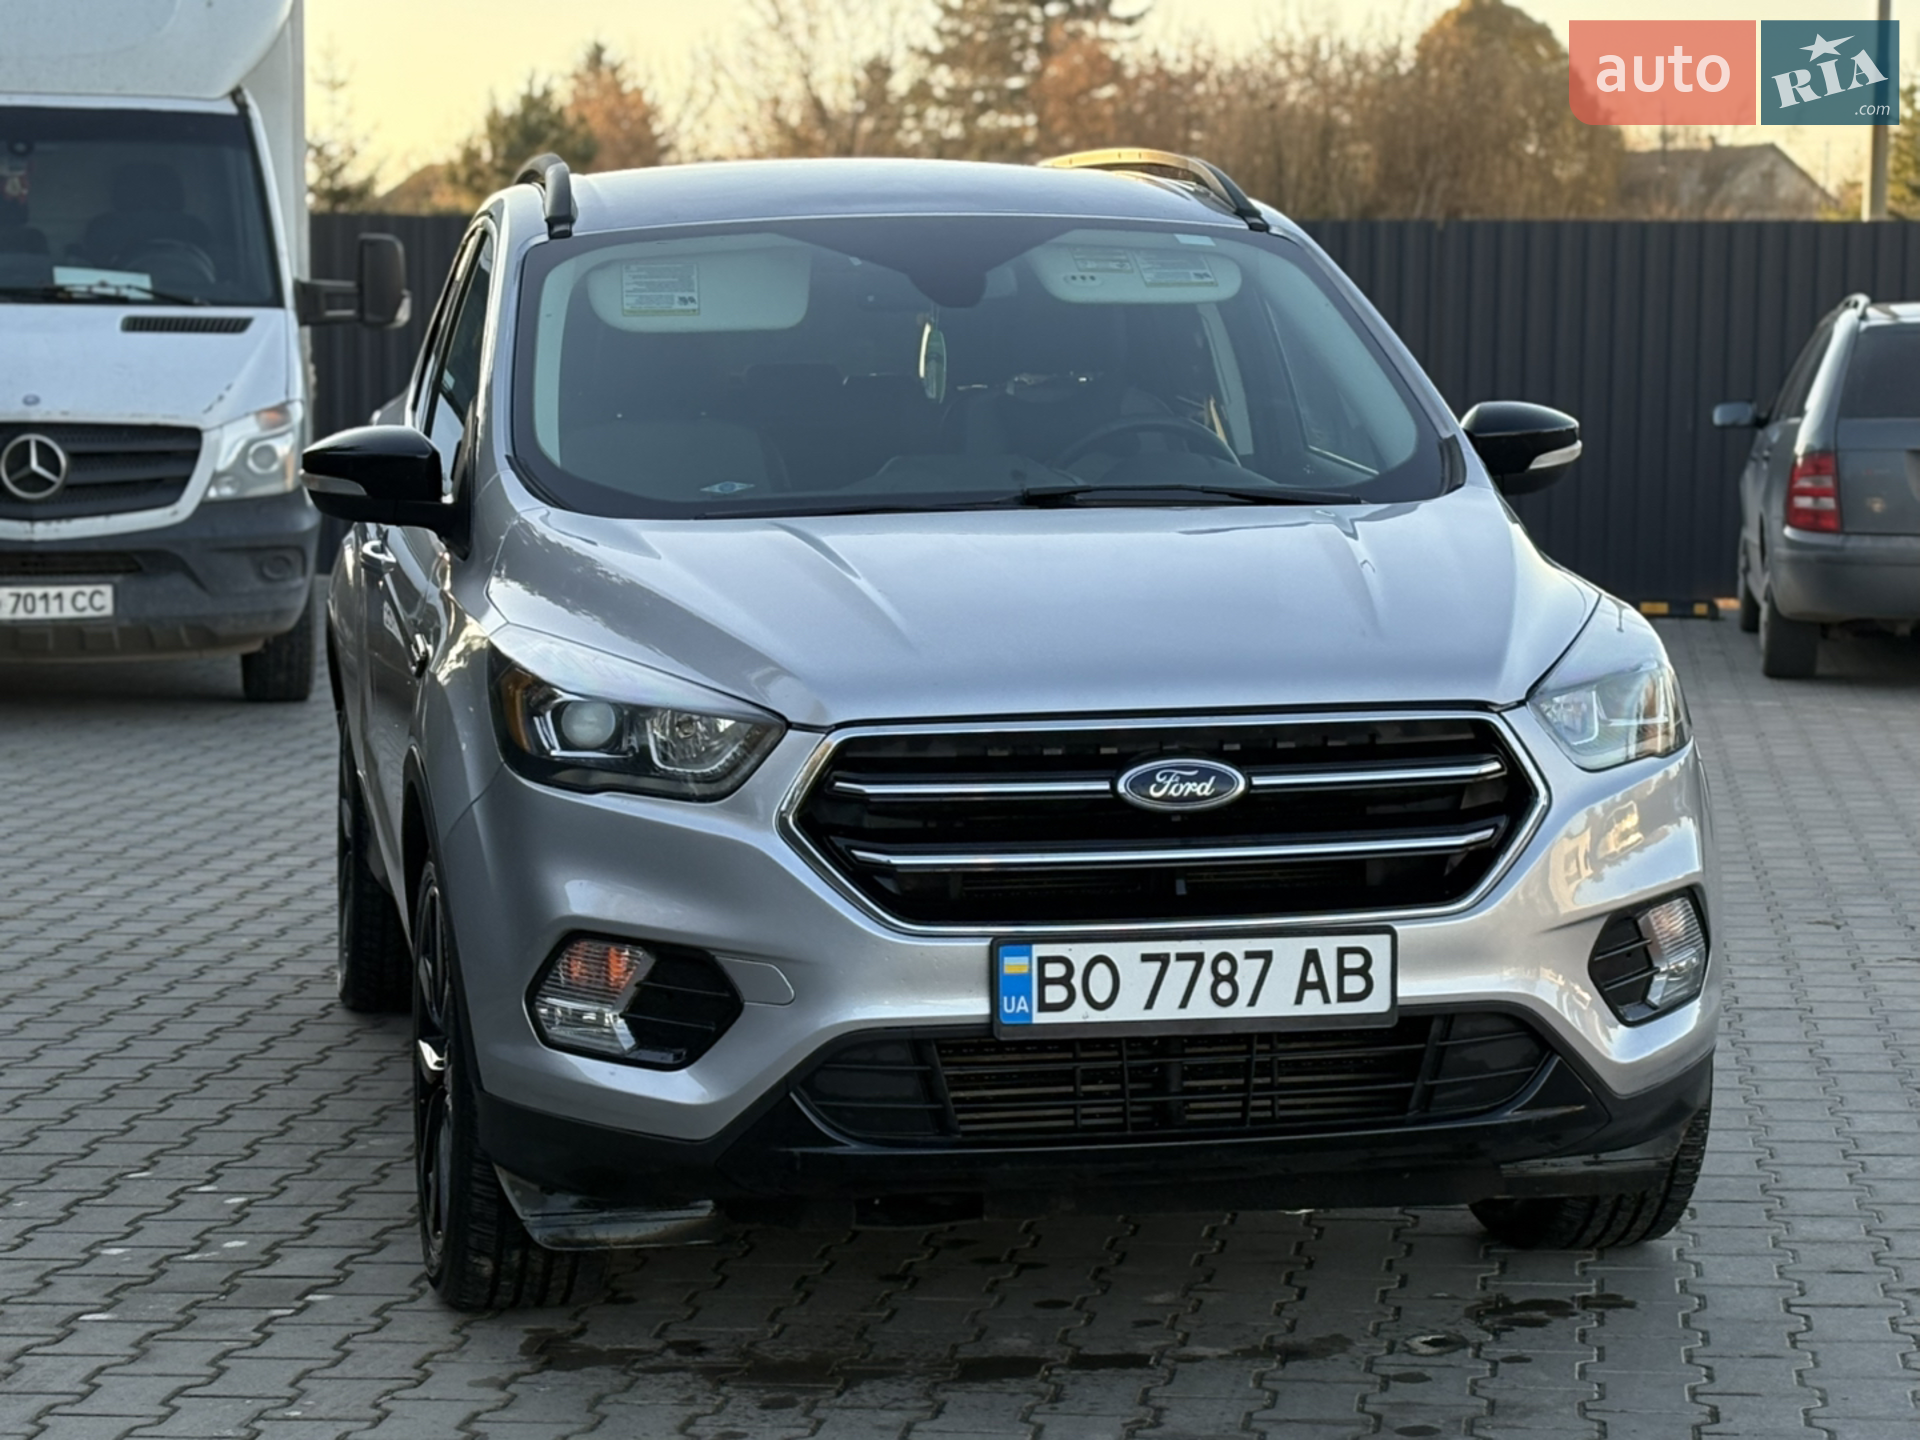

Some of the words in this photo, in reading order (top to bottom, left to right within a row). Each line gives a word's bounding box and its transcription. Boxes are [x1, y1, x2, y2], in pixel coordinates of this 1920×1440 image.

[8, 591, 64, 615] 7011
[70, 589, 106, 613] CC
[1149, 769, 1217, 798] Ford
[1036, 954, 1121, 1013] BO
[1140, 949, 1274, 1010] 7787
[1294, 946, 1375, 1006] AB
[1003, 995, 1030, 1014] UA
